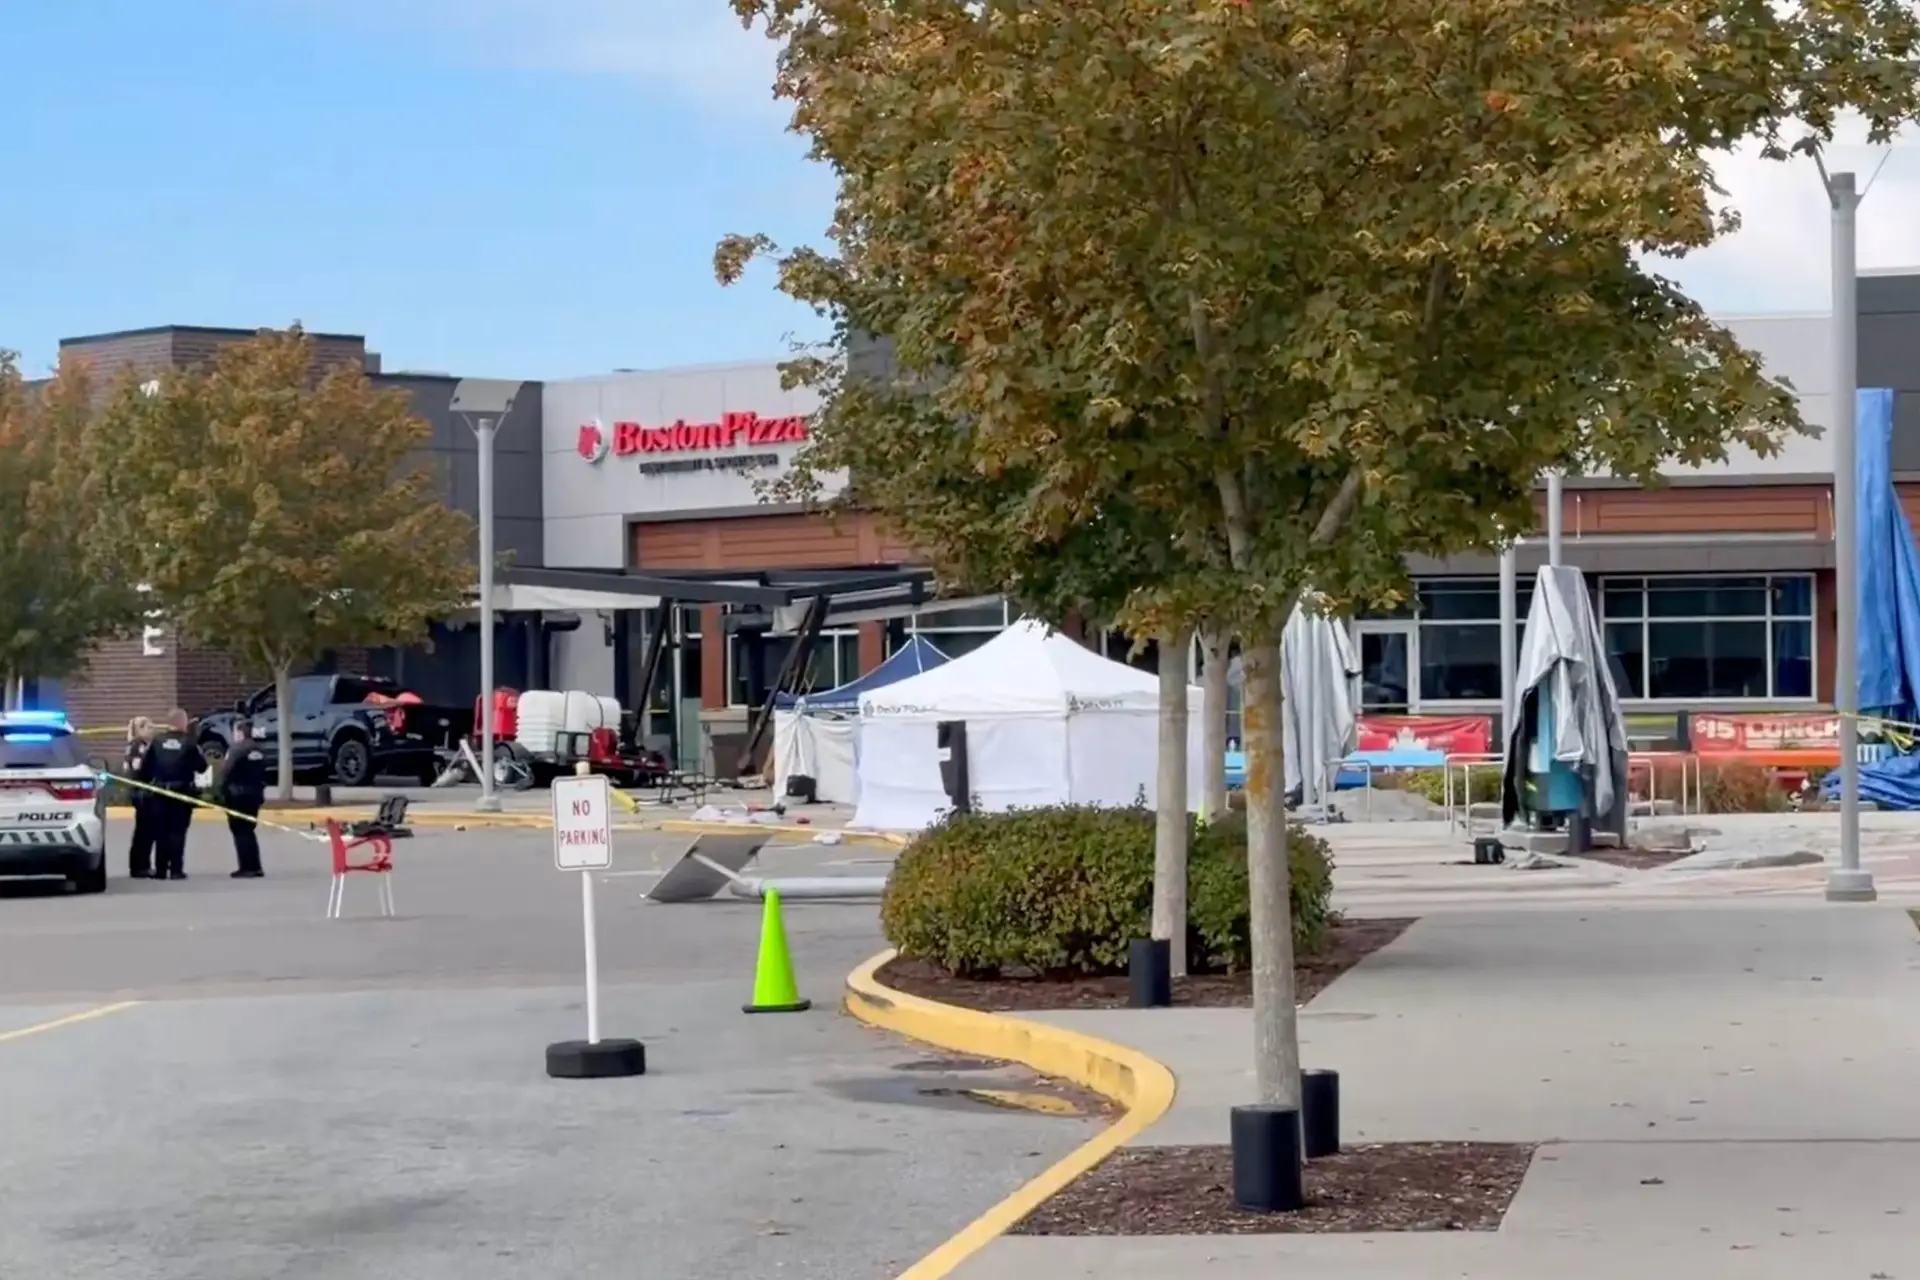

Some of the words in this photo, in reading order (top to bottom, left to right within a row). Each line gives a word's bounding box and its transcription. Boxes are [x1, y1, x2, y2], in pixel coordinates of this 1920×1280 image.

[614, 420, 723, 456] Boston
[722, 412, 808, 447] Pizza
[1695, 718, 1737, 739] $15
[1745, 719, 1841, 739] LUNCH
[18, 811, 73, 822] POLICE
[572, 799, 590, 816] NO
[559, 828, 606, 847] PARKING
